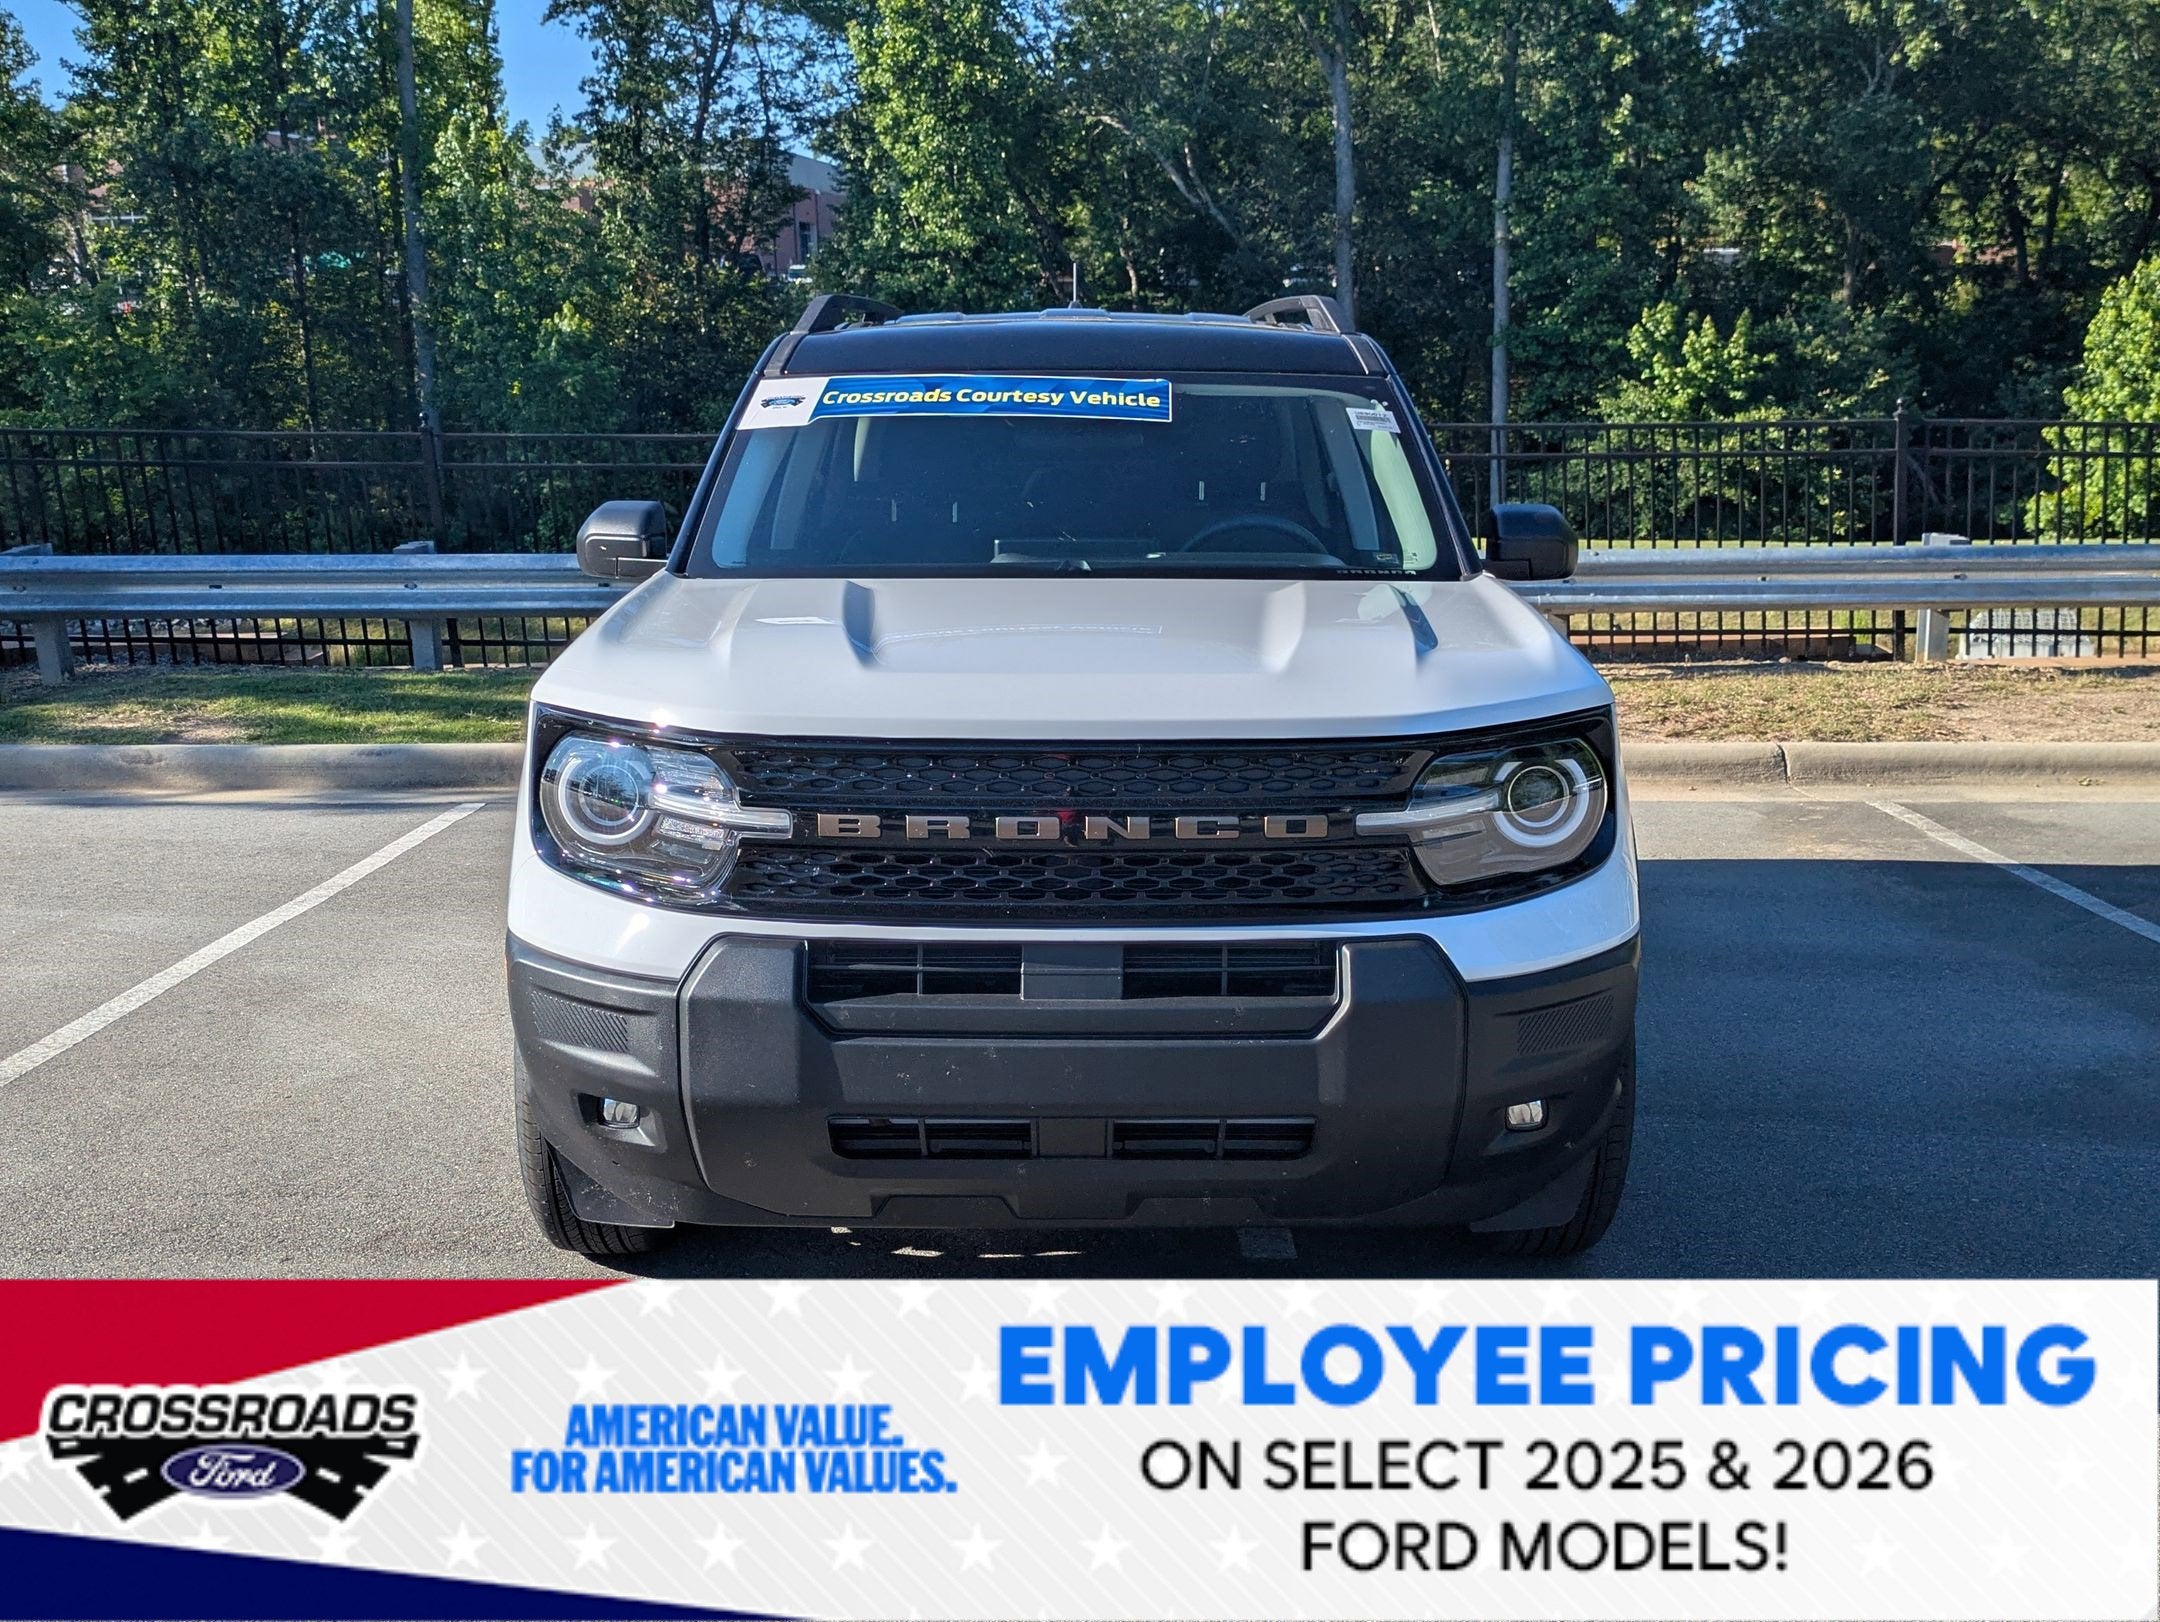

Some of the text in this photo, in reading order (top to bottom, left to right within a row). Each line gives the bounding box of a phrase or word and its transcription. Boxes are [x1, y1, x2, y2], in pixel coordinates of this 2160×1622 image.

[823, 388, 1161, 408] Crossroads Courtesy Vehicle
[817, 813, 1329, 839] BRONCO
